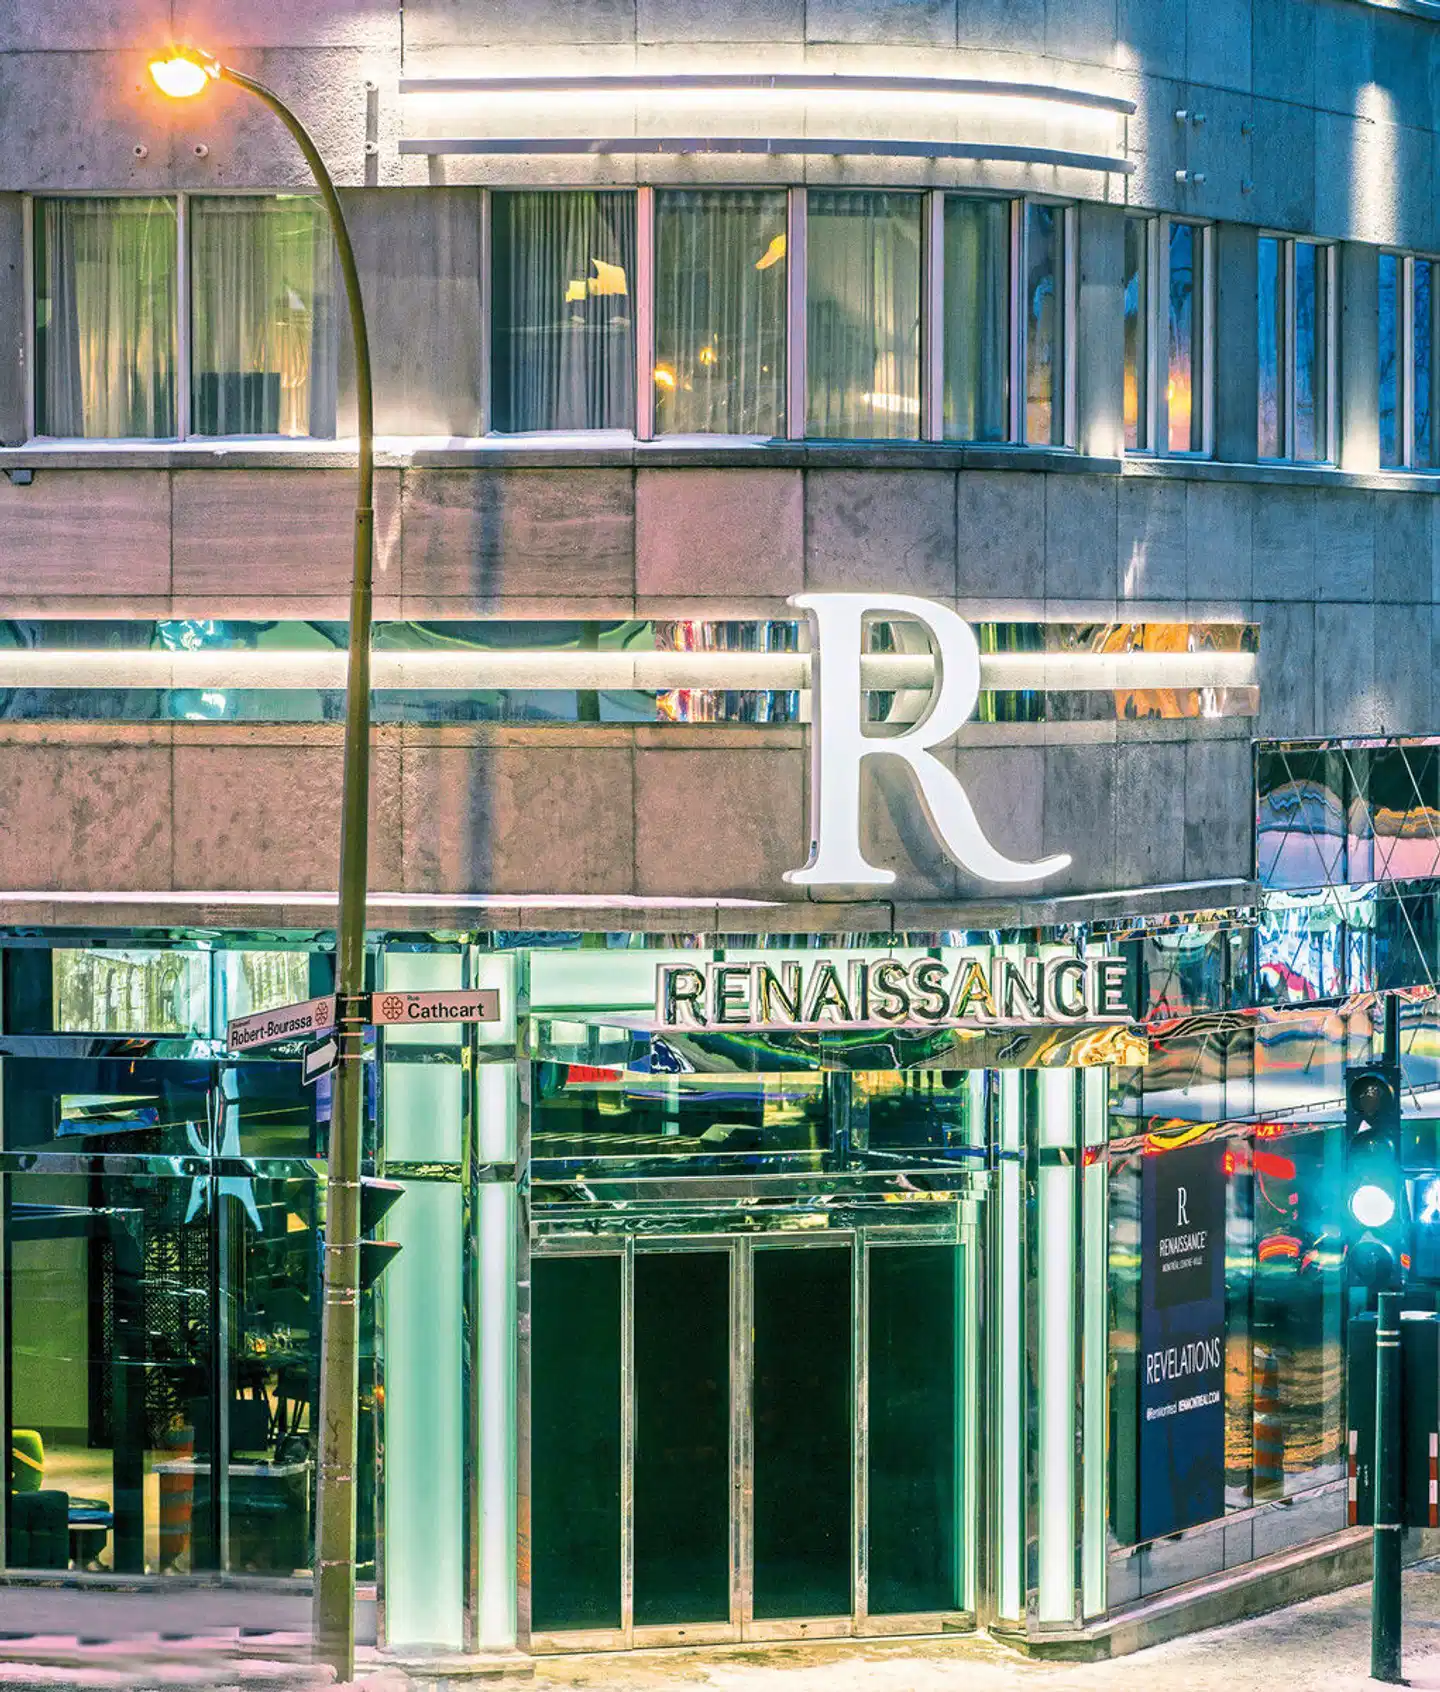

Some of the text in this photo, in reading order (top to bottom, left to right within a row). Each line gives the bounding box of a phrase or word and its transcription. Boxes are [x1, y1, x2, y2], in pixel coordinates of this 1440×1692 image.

[782, 593, 1072, 884] R
[407, 1002, 484, 1019] Cathcart
[655, 956, 1134, 1026] RENAISSANCE
[231, 1016, 313, 1047] Robert-Bourassa
[1177, 1186, 1190, 1226] R
[1146, 1337, 1221, 1385] REVELATIONS
